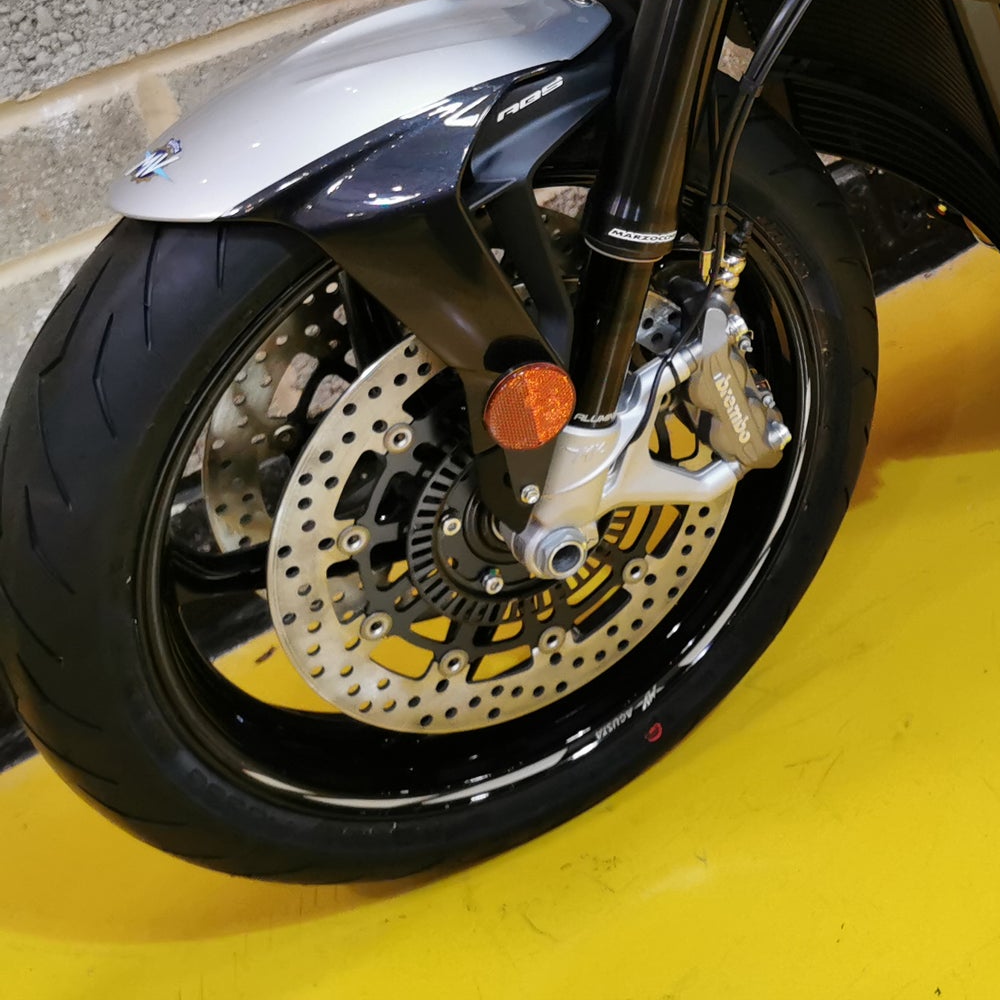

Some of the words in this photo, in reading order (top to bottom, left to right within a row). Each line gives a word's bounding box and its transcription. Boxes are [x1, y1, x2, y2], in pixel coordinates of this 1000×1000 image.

[497, 75, 563, 123] ABS
[612, 230, 675, 241] MARZOCC
[715, 373, 751, 444] brembo
[595, 707, 633, 740] AGUSTA
